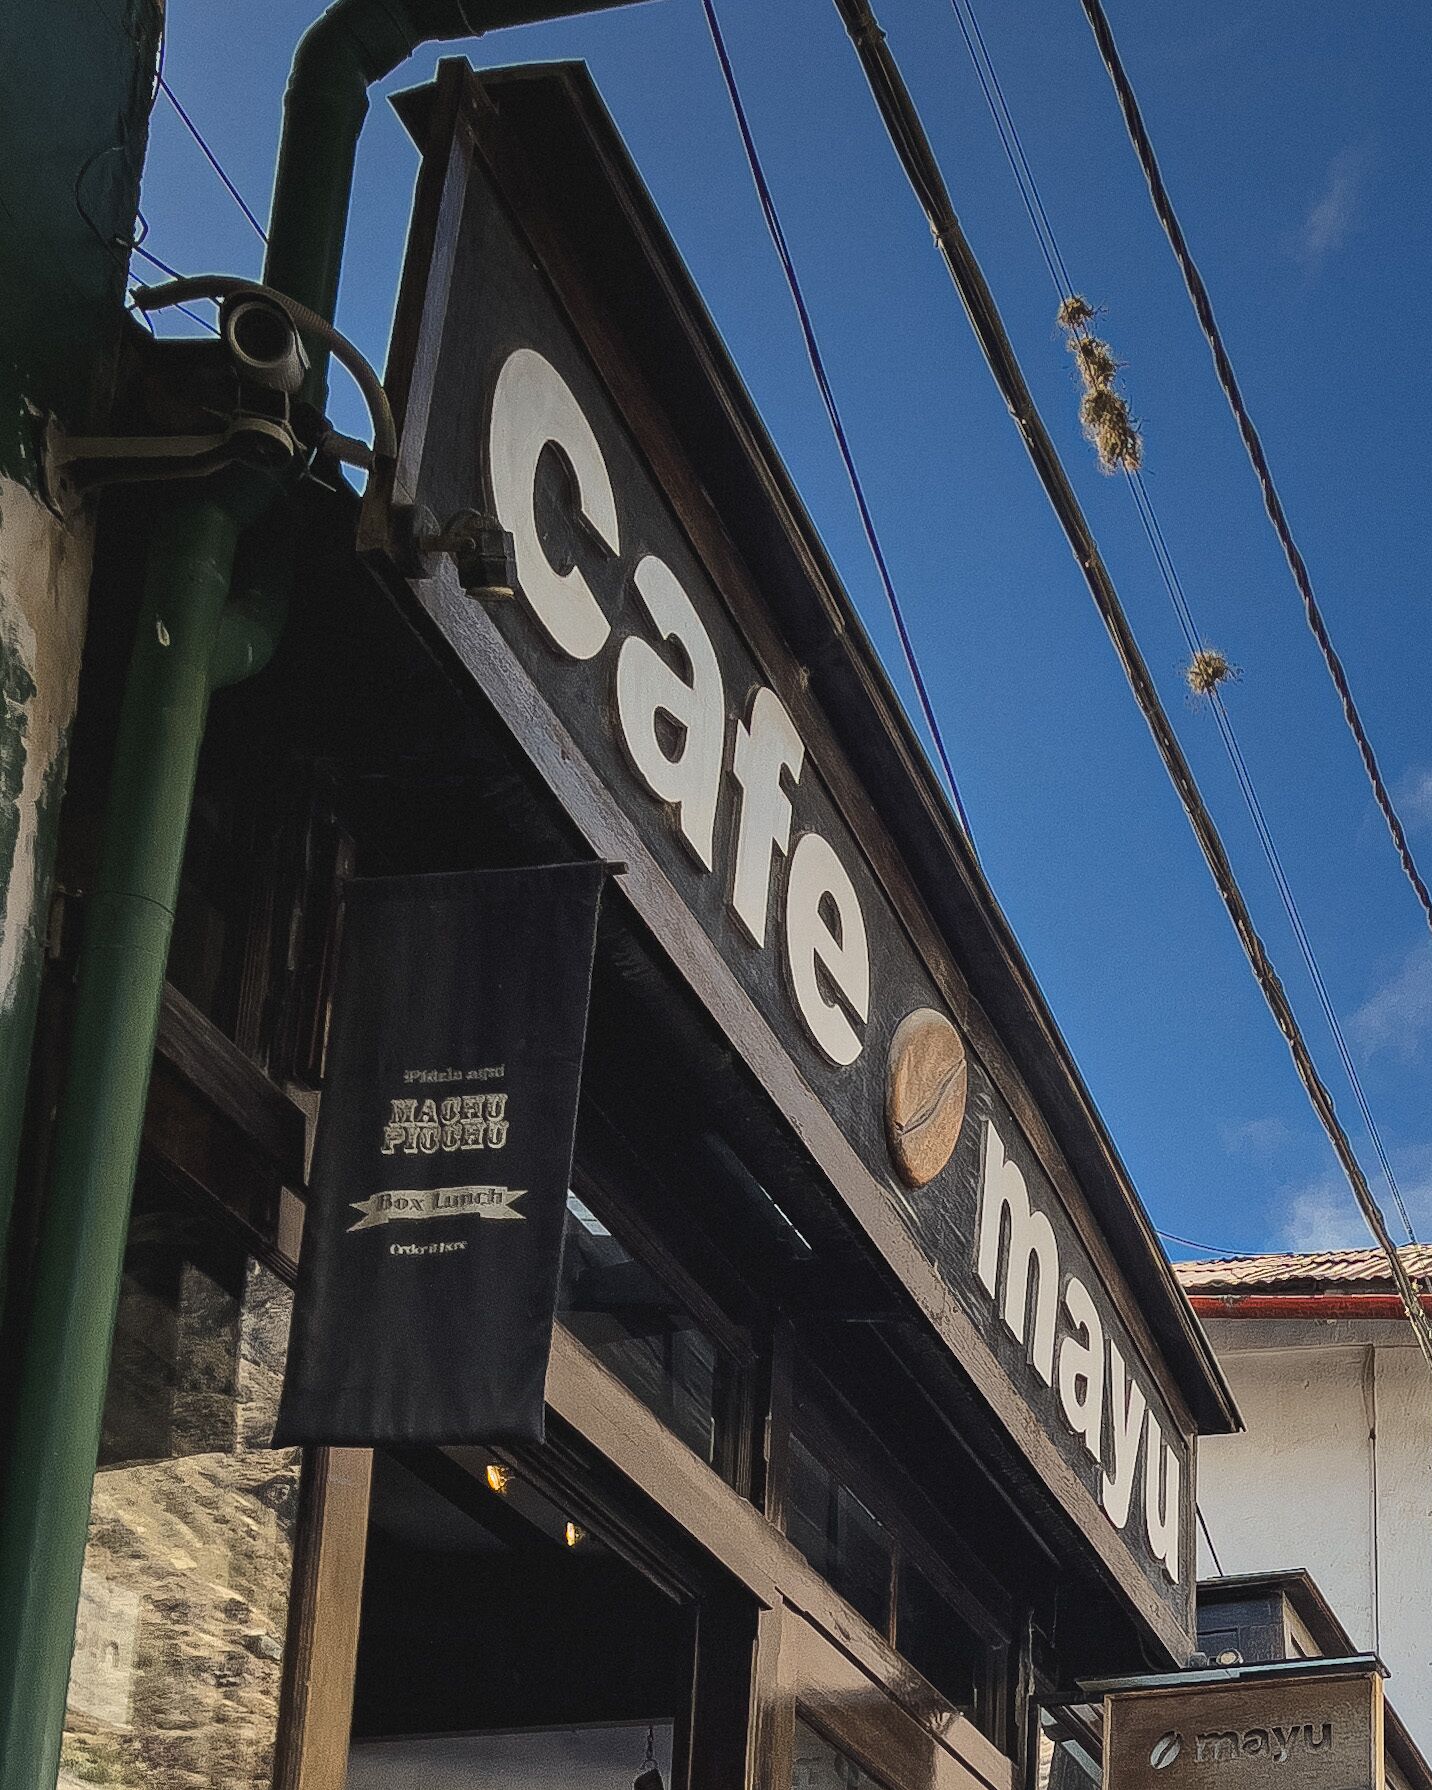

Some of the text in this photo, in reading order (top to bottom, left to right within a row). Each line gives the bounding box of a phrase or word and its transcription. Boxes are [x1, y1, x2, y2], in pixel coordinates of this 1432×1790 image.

[488, 348, 1181, 1585] cafe mayu
[389, 1093, 508, 1127] MACHU
[381, 1119, 510, 1155] PICCHU
[373, 1188, 503, 1211] Box Lunch
[1194, 1722, 1333, 1764] mayu
